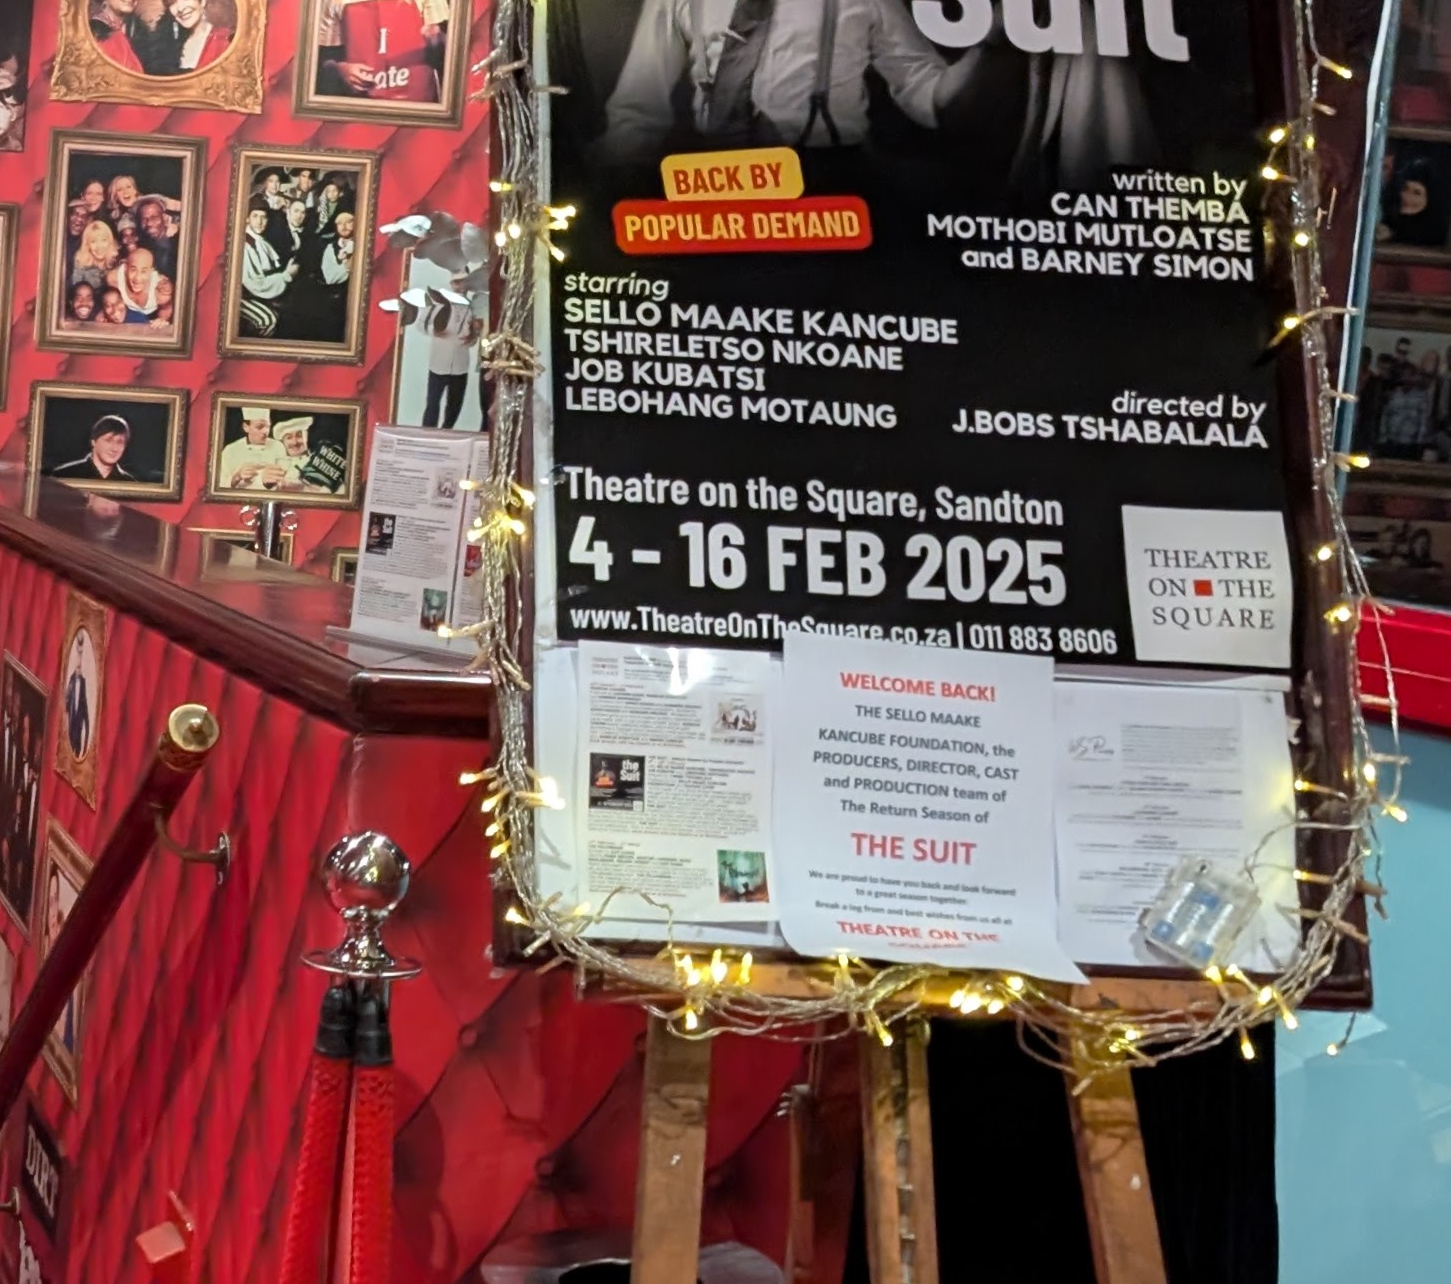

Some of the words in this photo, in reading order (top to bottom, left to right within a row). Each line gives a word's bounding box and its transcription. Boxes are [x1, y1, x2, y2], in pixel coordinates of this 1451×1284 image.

[672, 165, 745, 195] BACK
[749, 162, 783, 190] BY
[1112, 169, 1206, 194] written
[1212, 170, 1248, 202] by
[1050, 192, 1118, 218] CAN
[1124, 195, 1251, 224] THEMBA
[624, 213, 746, 242] POPULAR
[752, 210, 861, 240] DEMAND
[927, 213, 1066, 245] MOTHOBI
[1075, 223, 1253, 253] MUTLOATSE
[961, 246, 1014, 270] and
[1020, 247, 1145, 277] BARNEY
[1153, 253, 1254, 282] SIMON
[564, 272, 669, 301] starring
[564, 297, 662, 327] SELLO
[670, 303, 794, 334] MAAKE
[802, 310, 959, 345] KANCUBE
[564, 328, 765, 363] TSHIRELETSO
[773, 340, 904, 371] NKOANE
[565, 358, 623, 383] JOB
[632, 361, 766, 391] KUBATSI
[565, 387, 733, 419] LEBOHANG
[741, 397, 898, 429] MOTAUNG
[1111, 390, 1223, 418] directed
[1231, 394, 1267, 424] by
[952, 408, 1055, 438] J.BOBS
[1061, 415, 1269, 449] TSHABALALA
[562, 466, 690, 505] Theatre
[699, 479, 738, 508] on
[747, 476, 798, 512] the
[806, 480, 926, 522] Square,
[935, 486, 1064, 526] Sandton
[568, 516, 613, 582] 4
[678, 522, 748, 590] 16
[766, 525, 887, 597] FEB
[904, 533, 1068, 607] 2025
[1143, 548, 1272, 570] THEATRE
[1148, 577, 1186, 597] ON
[1217, 578, 1275, 599] THE
[1152, 606, 1275, 630] SQUARE
[968, 623, 1004, 650] 011
[1008, 624, 1054, 652] 883
[1057, 627, 1118, 654] 8606
[840, 671, 935, 697] WELCOME
[942, 681, 996, 702] BACK!
[855, 704, 881, 719] THE
[886, 707, 926, 723] SELLO
[930, 712, 981, 728] MAAKE
[818, 727, 886, 746] KANCUBE
[890, 734, 989, 757] FOUNDATION,
[993, 744, 1015, 758] the
[813, 750, 902, 773] PRODUCERS,
[906, 759, 980, 780] DIRECTOR,
[984, 765, 1019, 781] CAST
[823, 775, 849, 789] and
[854, 777, 949, 798] PRODUCTION
[954, 787, 988, 801] team
[992, 788, 1006, 803] of
[841, 799, 865, 813] The
[870, 802, 917, 819] Return
[921, 806, 970, 822] Season
[975, 809, 989, 824] of
[851, 832, 904, 860] THE
[913, 837, 976, 865] SUIT
[809, 870, 823, 879] We
[826, 872, 839, 880] are
[841, 873, 867, 884] proud
[870, 875, 878, 884] to
[880, 876, 901, 886] have
[903, 879, 919, 889] you
[921, 879, 941, 891] back
[943, 882, 960, 892] and
[856, 887, 865, 896] to
[874, 889, 897, 900] great
[899, 892, 928, 902] season
[815, 900, 840, 910] Break
[849, 903, 862, 914] leg
[864, 903, 885, 914] from
[887, 906, 903, 917] and
[905, 908, 923, 918] best
[837, 920, 921, 939] THEATRE
[929, 928, 958, 941] ON
[962, 931, 1000, 943] THE
